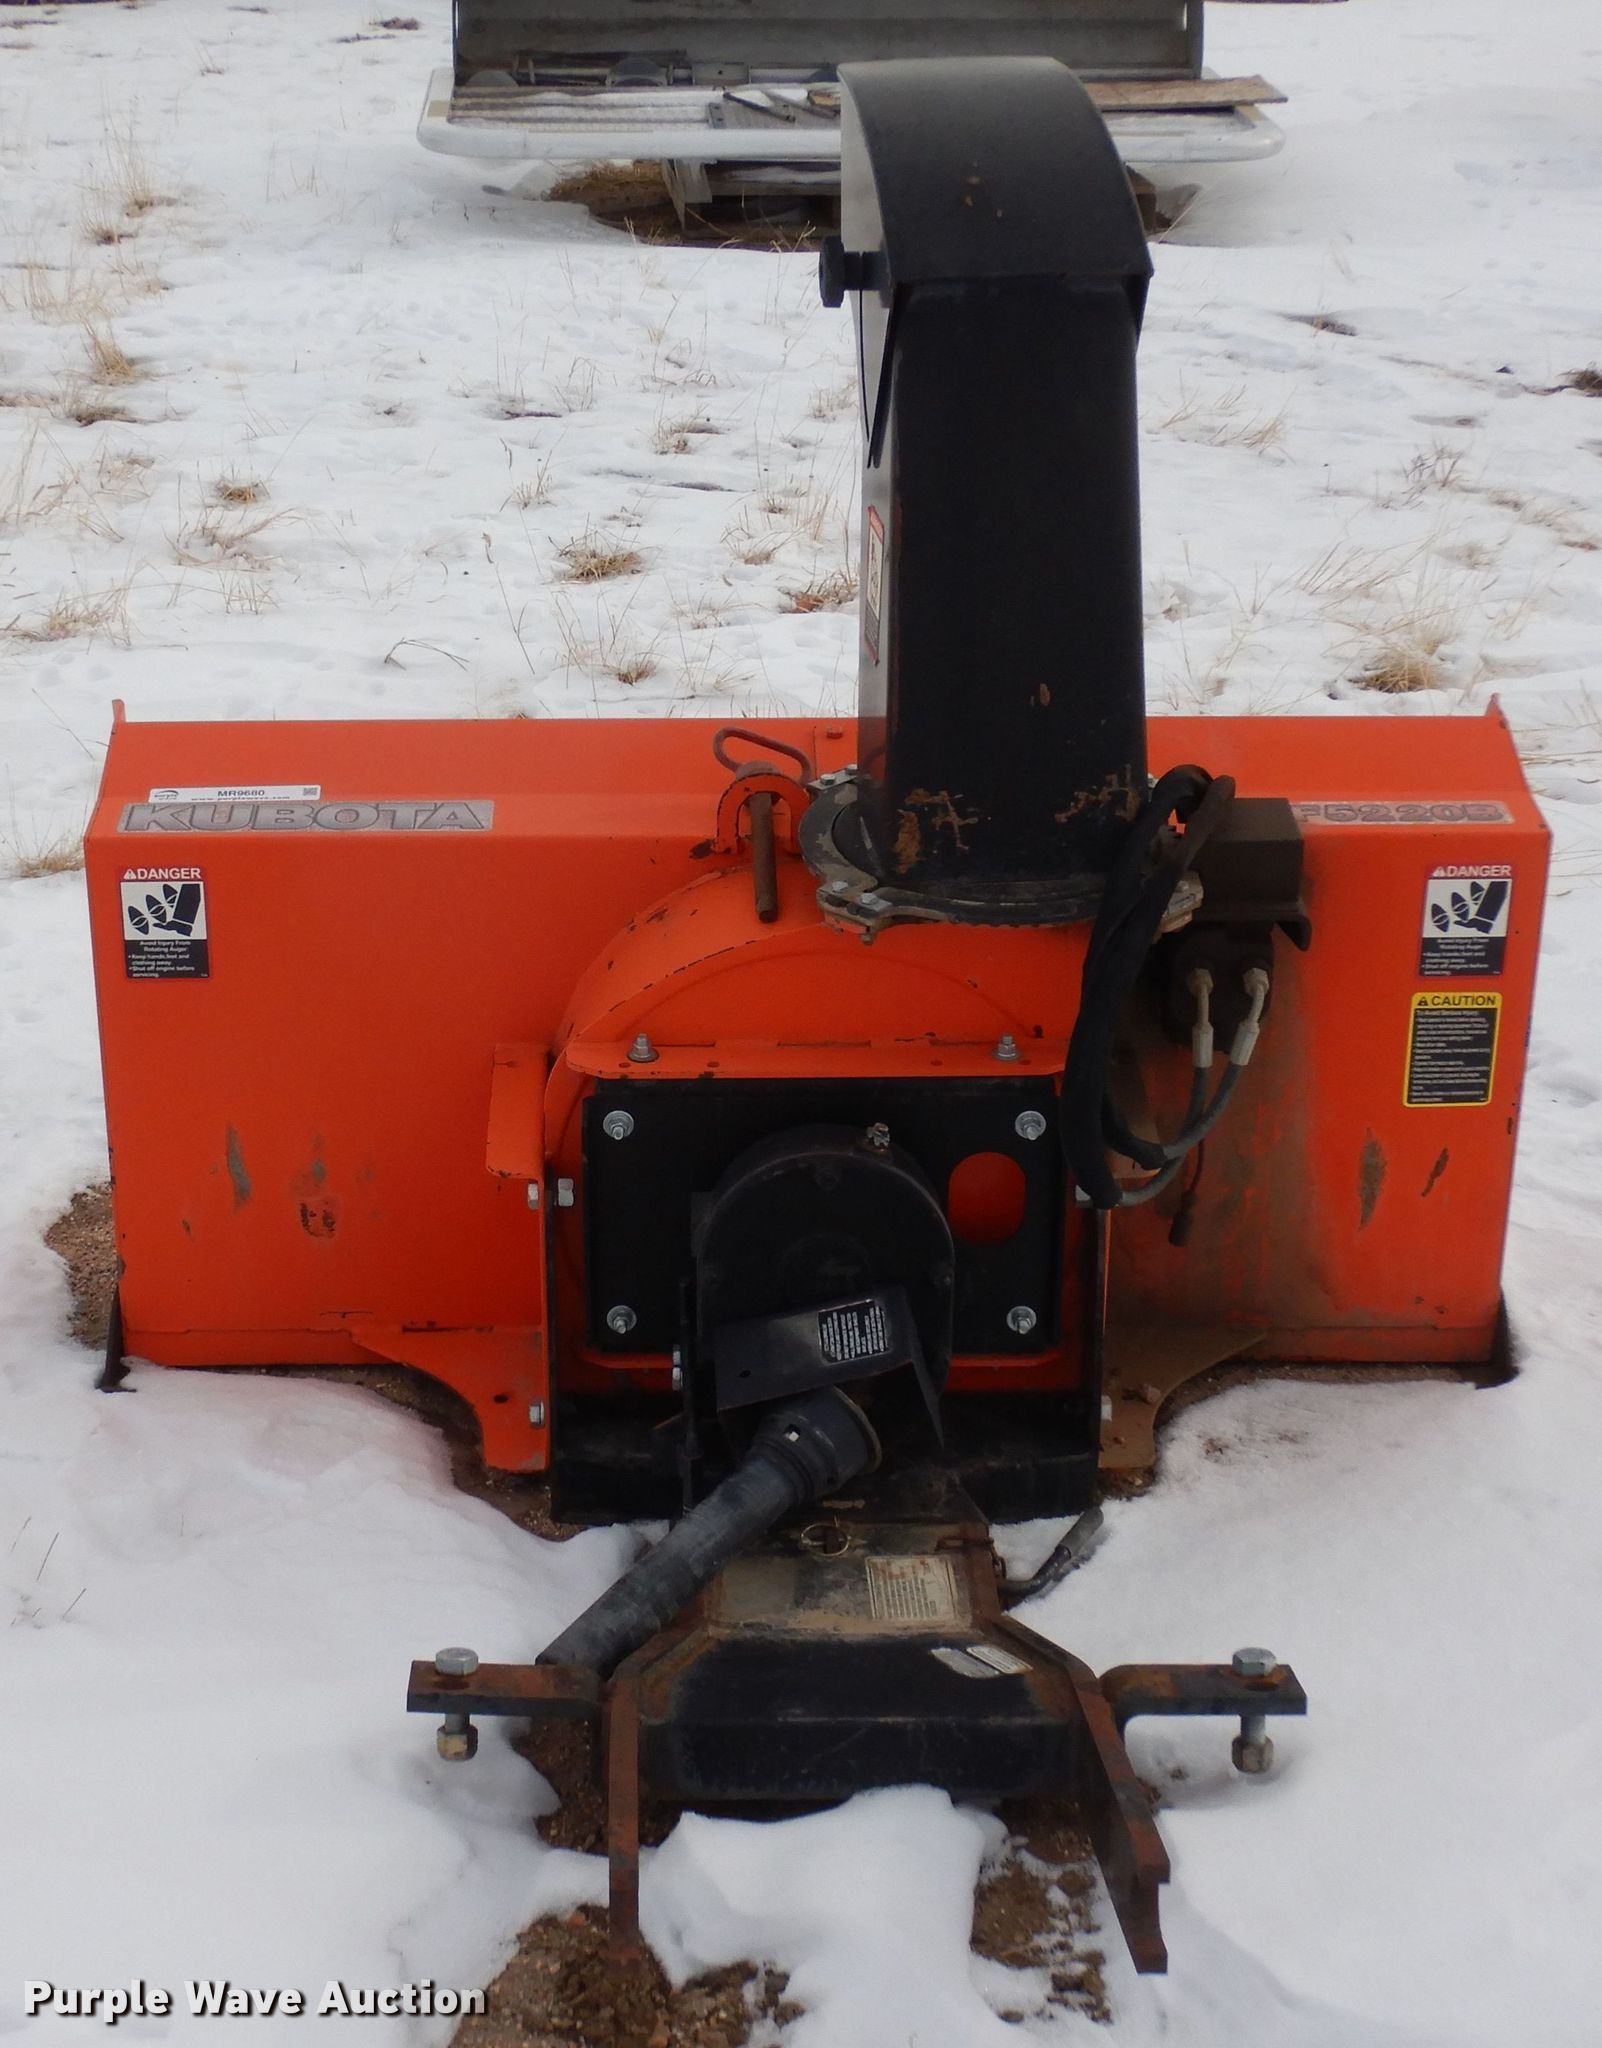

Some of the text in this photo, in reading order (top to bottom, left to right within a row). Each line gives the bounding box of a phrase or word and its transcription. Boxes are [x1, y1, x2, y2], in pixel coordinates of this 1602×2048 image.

[217, 789, 266, 797] MR9680
[124, 802, 485, 831] KUBOTA
[136, 868, 202, 879] DANGER
[1446, 865, 1512, 877] DANGER
[1431, 995, 1496, 1006] CAUTION
